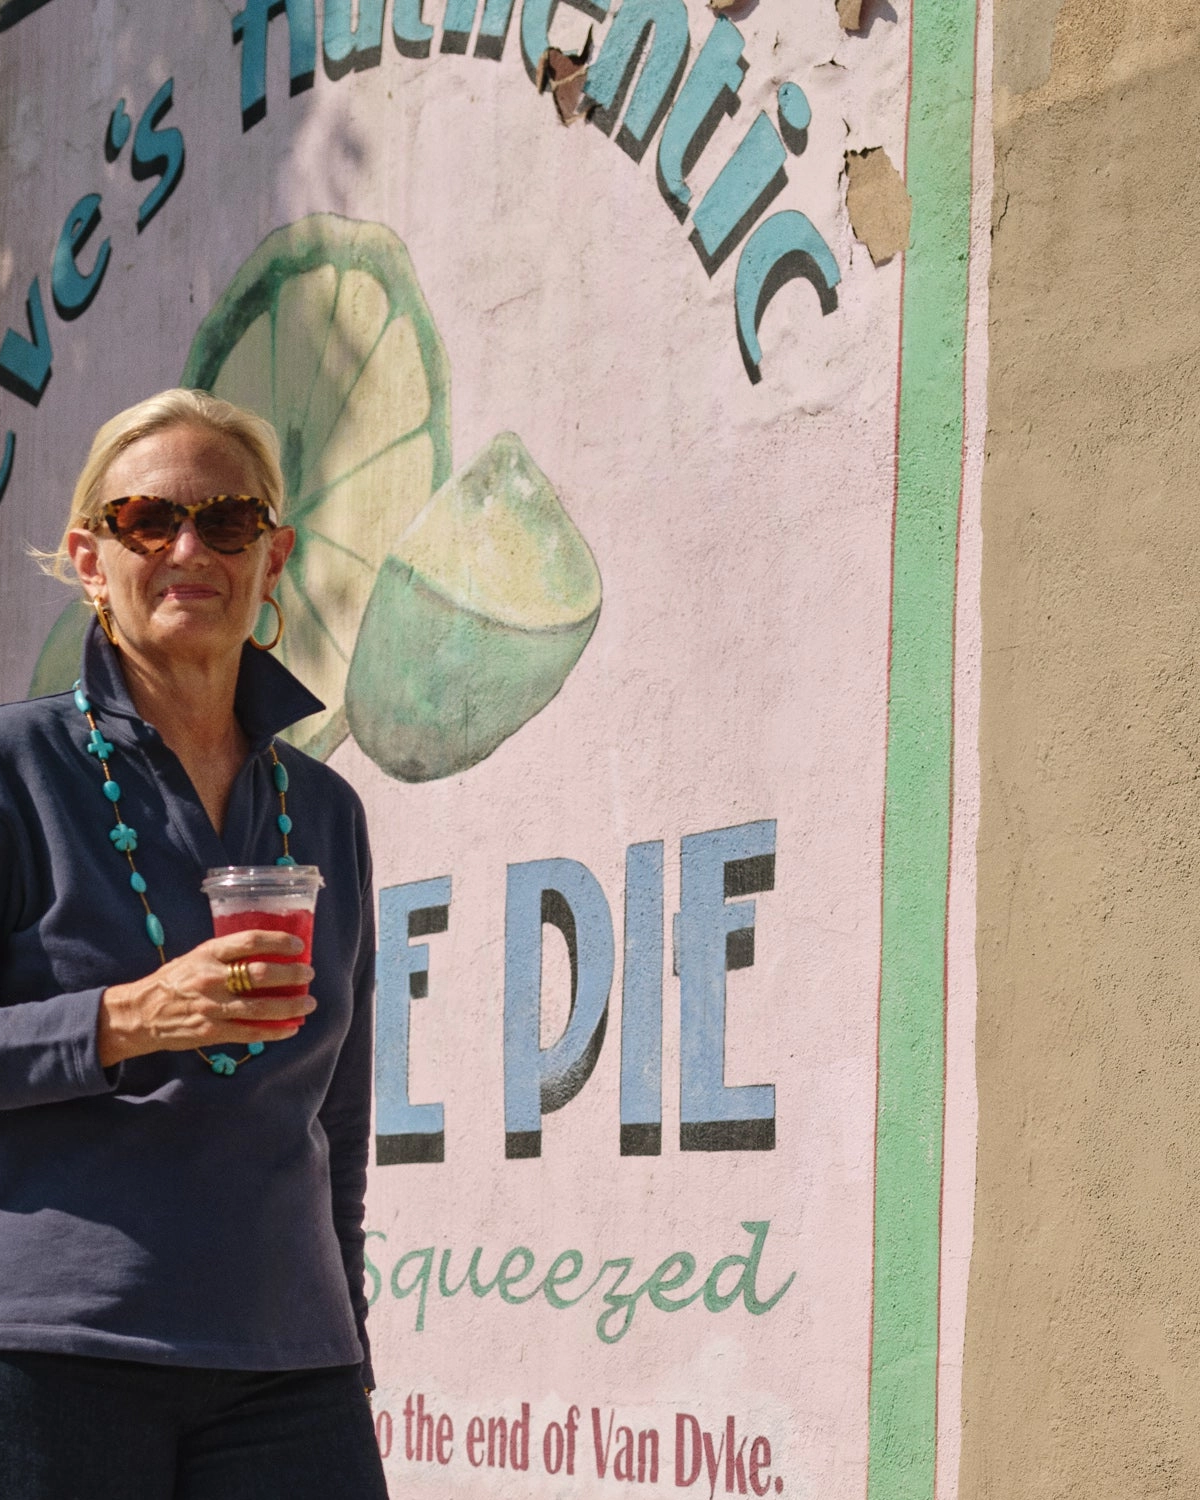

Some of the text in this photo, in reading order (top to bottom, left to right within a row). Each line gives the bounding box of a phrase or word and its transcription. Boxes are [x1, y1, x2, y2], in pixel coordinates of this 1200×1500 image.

[503, 818, 778, 1160] PIE
[402, 1389, 454, 1465] the
[466, 1401, 531, 1471] end
[543, 1404, 581, 1476] of
[591, 1406, 660, 1484] Van
